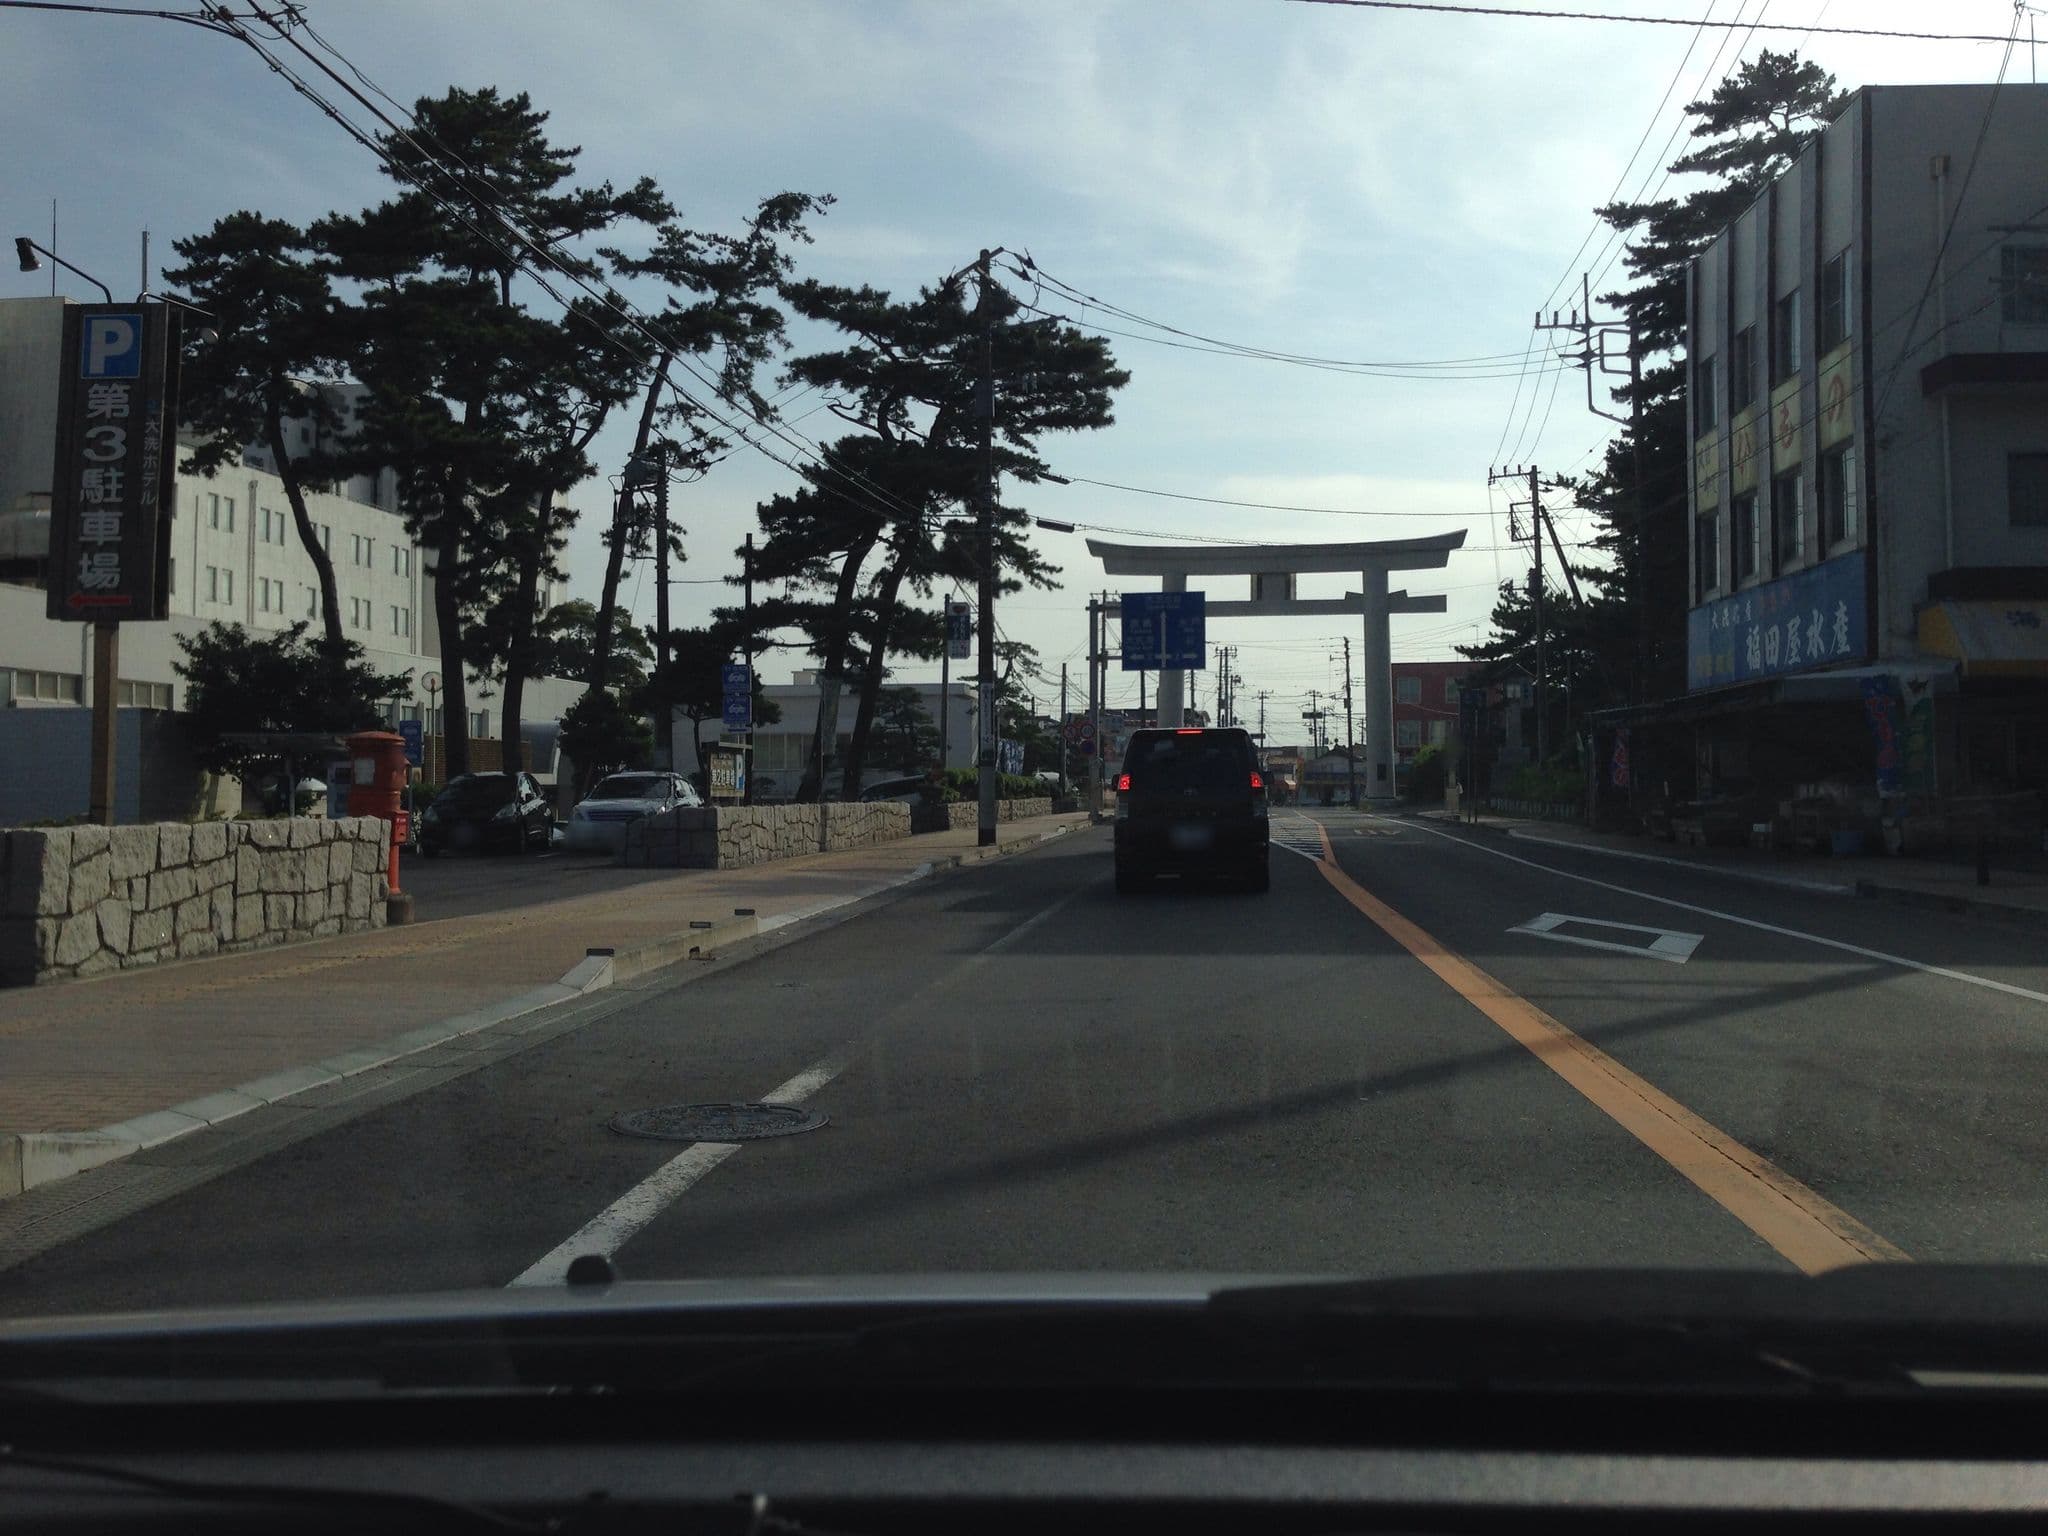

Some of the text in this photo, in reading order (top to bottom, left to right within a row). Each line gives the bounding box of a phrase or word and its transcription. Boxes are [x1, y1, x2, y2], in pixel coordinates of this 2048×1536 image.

[89, 319, 134, 375] P
[77, 382, 131, 590] 第3駐車場
[141, 418, 160, 505] 大洗ホテル
